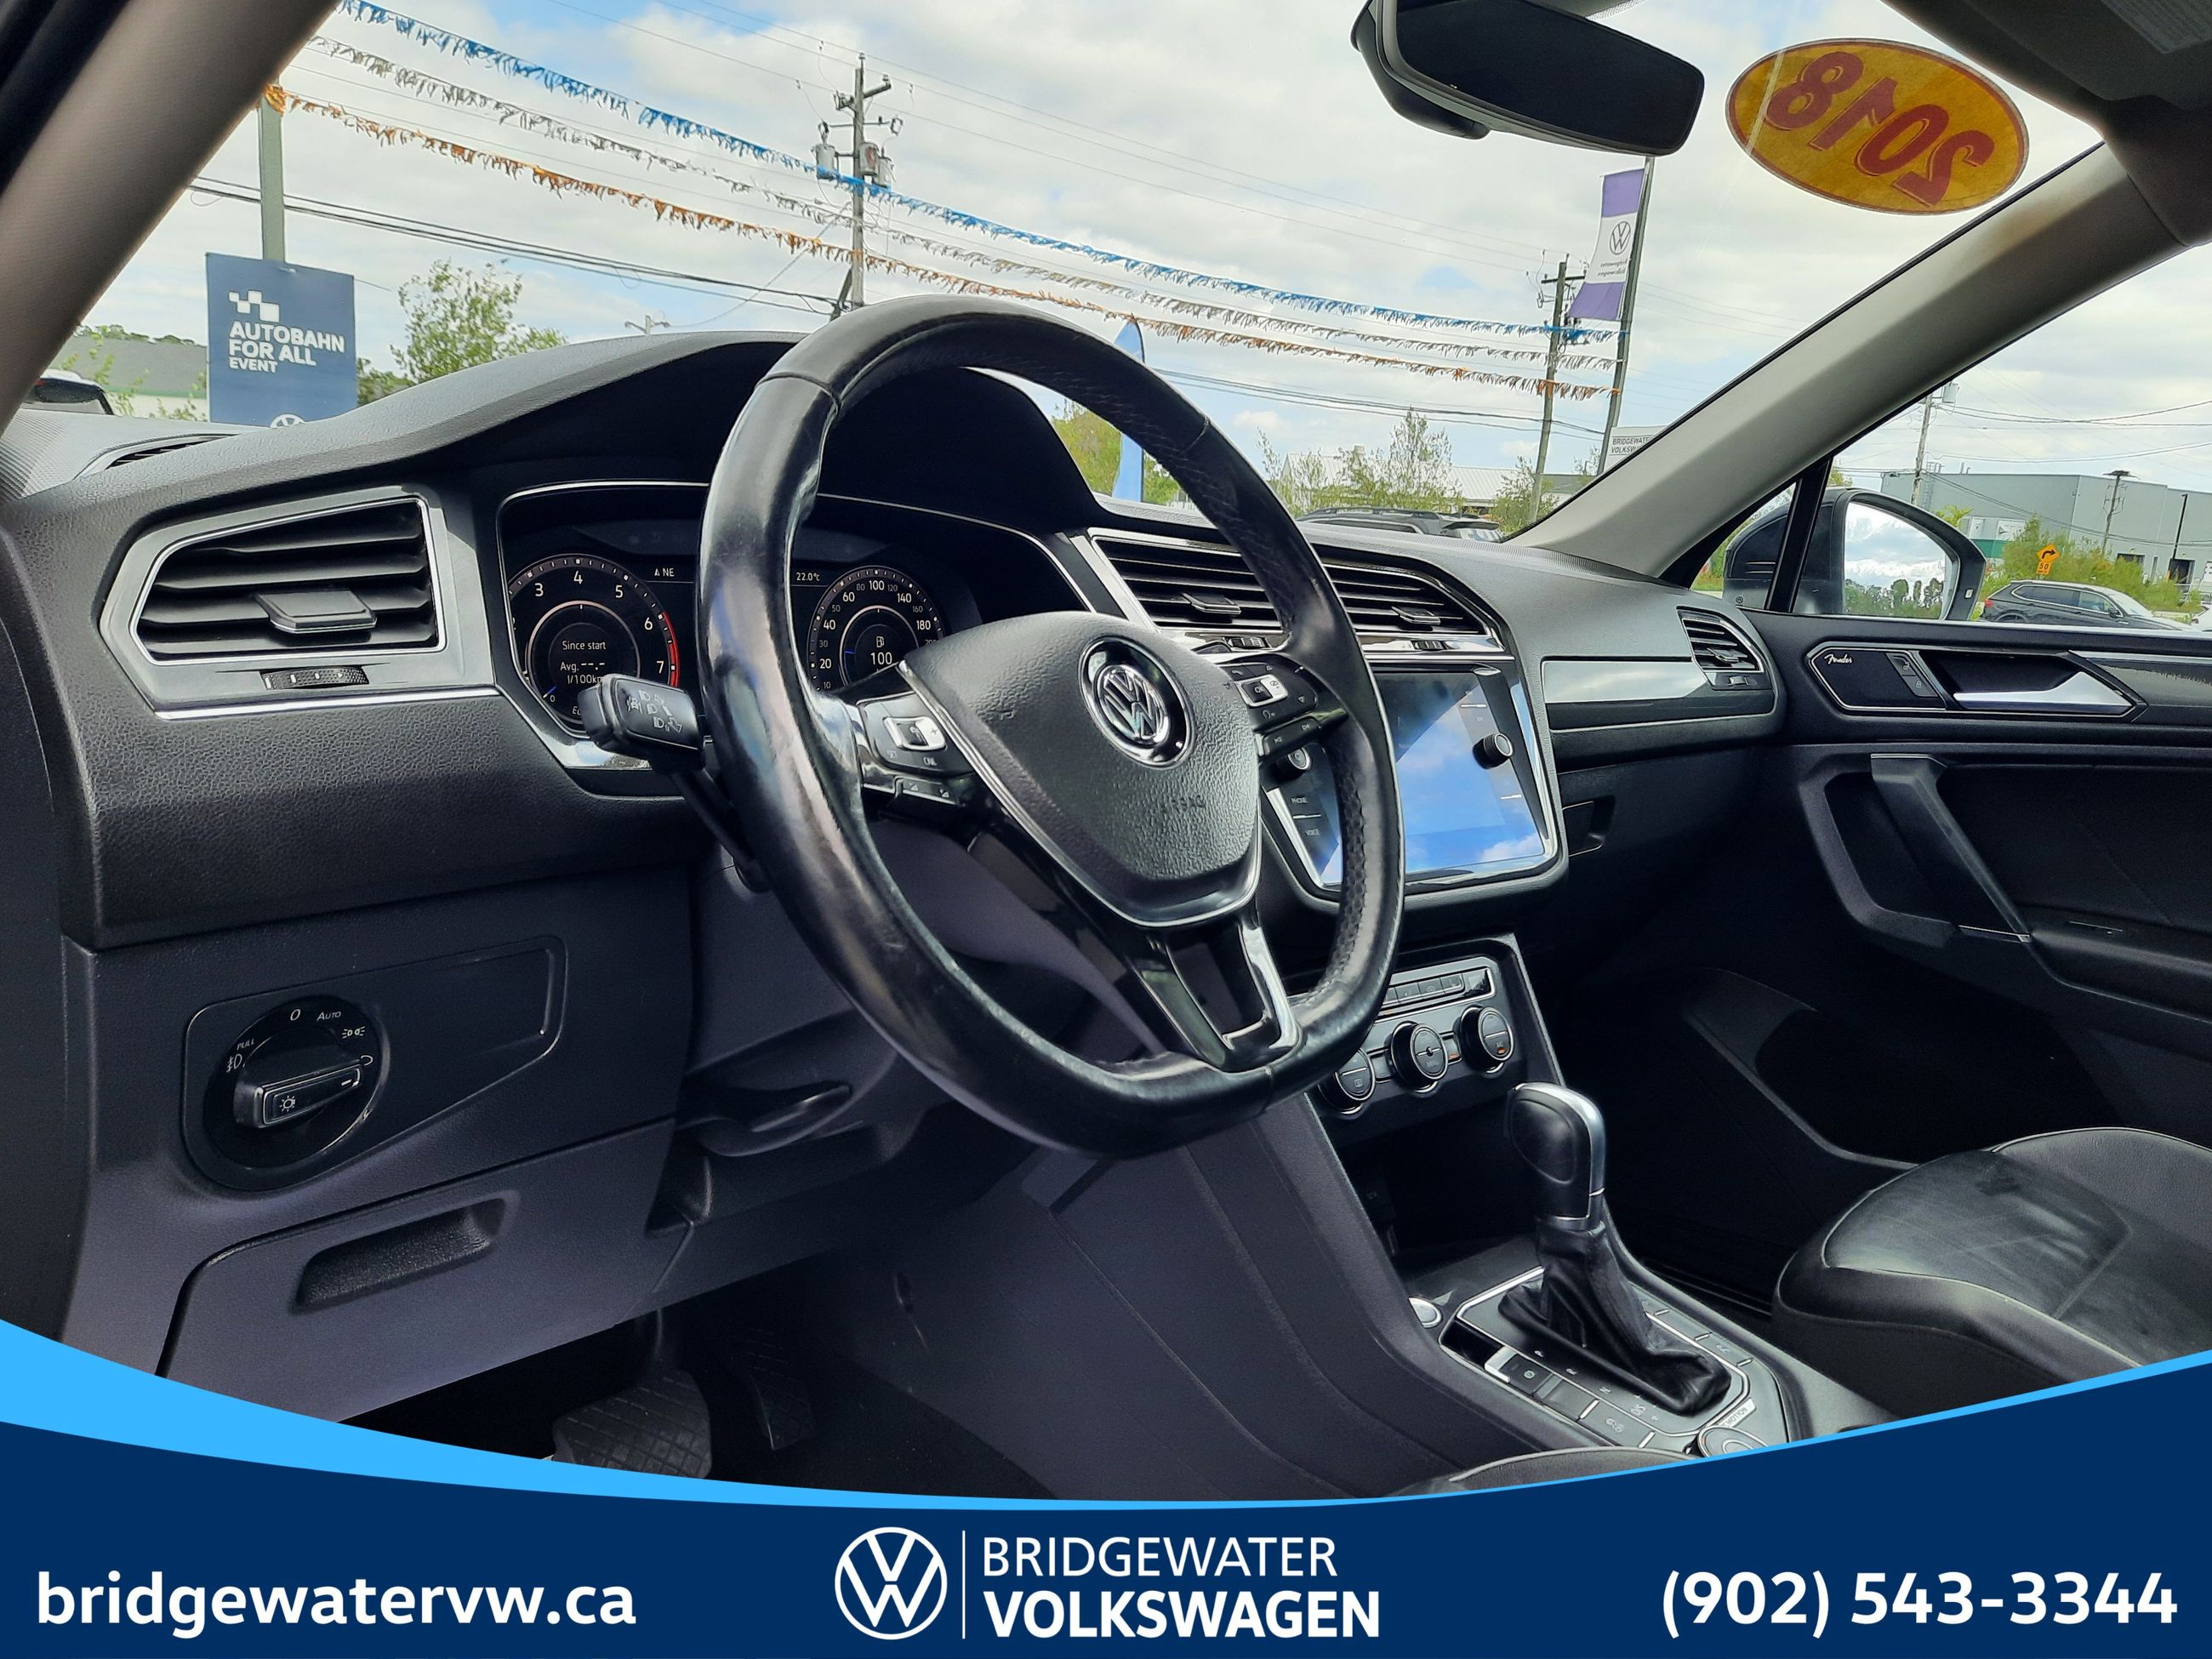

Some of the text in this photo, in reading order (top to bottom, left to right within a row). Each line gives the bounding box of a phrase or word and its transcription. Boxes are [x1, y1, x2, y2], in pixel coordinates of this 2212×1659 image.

[229, 320, 345, 353] AUTOBAHN
[229, 339, 317, 367] FOR ALL
[229, 357, 278, 373] EVENT
[1612, 436, 1652, 446] BRIDGEWATE
[573, 571, 584, 584] 4
[663, 567, 675, 577] NE
[534, 583, 544, 597] 3
[615, 584, 624, 598] 5
[856, 583, 866, 591] 80
[869, 580, 885, 591] 100
[842, 592, 856, 602] 60
[897, 593, 912, 603] 140
[644, 617, 653, 630] 6
[823, 620, 836, 630] 40
[916, 620, 932, 630] 180
[562, 640, 607, 651] Since start
[819, 658, 832, 670] 20
[871, 653, 892, 665] 100
[560, 661, 579, 673] Avg.
[656, 660, 664, 674] 7
[237, 1038, 255, 1051] PULL
